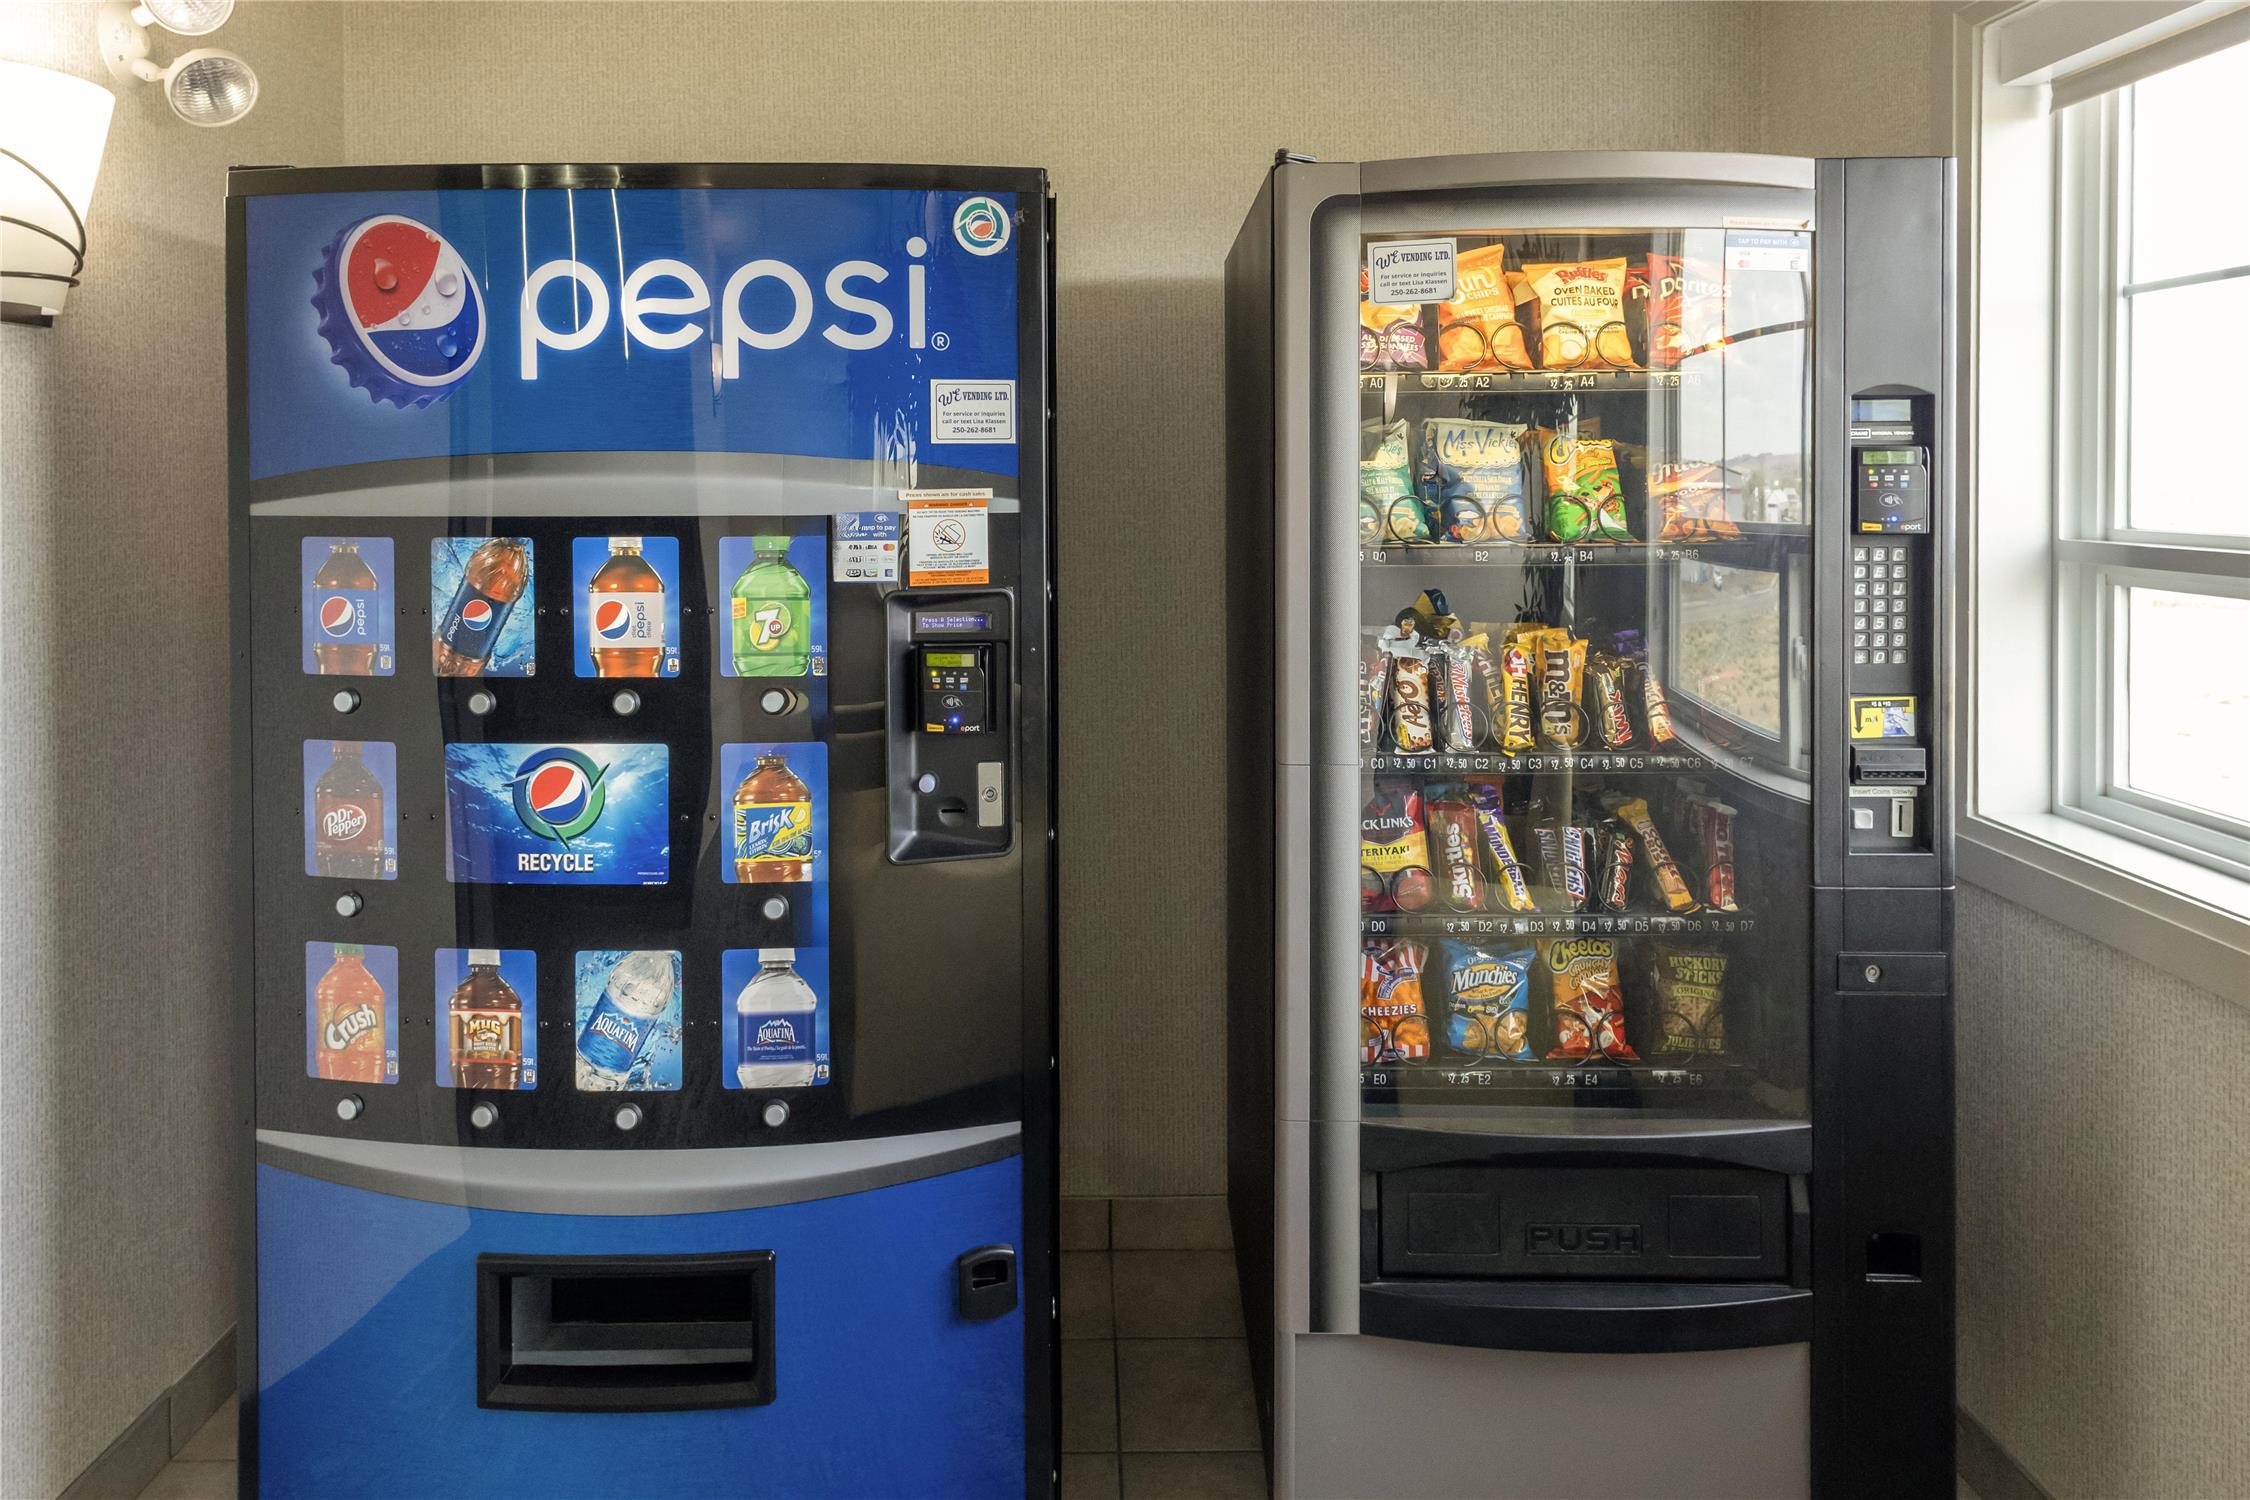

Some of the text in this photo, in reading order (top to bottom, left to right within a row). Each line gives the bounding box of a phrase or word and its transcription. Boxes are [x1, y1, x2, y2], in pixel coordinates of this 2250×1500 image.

[1400, 251, 1433, 263] VENDING
[1435, 250, 1451, 261] LTD.
[1420, 271, 1447, 279] inquiries
[1555, 266, 1608, 284] Ruffles
[1390, 287, 1437, 296] 250-262-8681
[1467, 287, 1500, 300] CHIPS
[1553, 285, 1615, 296] OVEN BAKED
[1660, 277, 1732, 300] Doritos
[1551, 296, 1581, 307] CUITES
[1583, 297, 1596, 307] AU
[521, 237, 925, 380] pepsi
[1369, 377, 1384, 389] A0
[1475, 377, 1490, 388] A2
[1550, 376, 1595, 391] $2.25 A4
[962, 391, 993, 401] VENDING
[994, 391, 1009, 401] LTD.
[1475, 551, 1489, 562] B2
[1551, 550, 1594, 565] $2.25 B4
[1686, 549, 1699, 560] B6
[1856, 550, 1865, 559] A
[1876, 550, 1885, 559] B
[1856, 567, 1865, 576] D
[1876, 567, 1885, 576] E
[1856, 584, 1904, 593] G H J
[1856, 601, 1904, 610] 1 2 3
[355, 599, 367, 636] pepsi
[634, 601, 647, 638] pepsi
[447, 613, 461, 642] pepsi
[1509, 678, 1531, 742] HENRY
[1371, 758, 1385, 769] C0
[1393, 758, 1437, 769] $2.50 C1
[1447, 758, 1489, 769] $2.50 C2
[1498, 758, 1542, 772] $2.50 C3
[1551, 757, 1594, 770] $2.50 C4
[1602, 757, 1644, 770] $2.50 C5
[1687, 757, 1701, 769] C6
[1892, 788, 1914, 796] Slowly
[337, 808, 353, 823] Dr
[327, 811, 364, 837] Pepper
[1361, 845, 1410, 857] TERIYAKI
[517, 853, 594, 872] RECYCLE
[1446, 823, 1473, 899] Skittles
[1371, 921, 1386, 932] D0
[1446, 921, 1493, 932] $2.50 D2
[1530, 921, 1544, 932] D3
[1552, 920, 1596, 932] $2.50 D4
[1604, 920, 1649, 932] $2.50 D5
[1687, 920, 1702, 931] D6
[1711, 920, 1754, 932] $2.50 D7
[1551, 939, 1612, 970] Cheetos
[1668, 956, 1728, 971] HICKORY
[1450, 965, 1518, 994] Munchies
[1675, 967, 1723, 984] STICKS
[1361, 1003, 1417, 1017] CHEEZIES
[326, 1003, 377, 1050] Crush
[469, 1019, 501, 1035] MUG
[591, 1013, 639, 1052] AQUAFINA
[756, 1025, 796, 1044] AQUAFINA
[1373, 1073, 1387, 1085] E0
[1478, 1073, 1491, 1085] E2
[1585, 1074, 1598, 1085] E4
[1690, 1073, 1703, 1085] E6
[1529, 1227, 1641, 1254] PUSH
